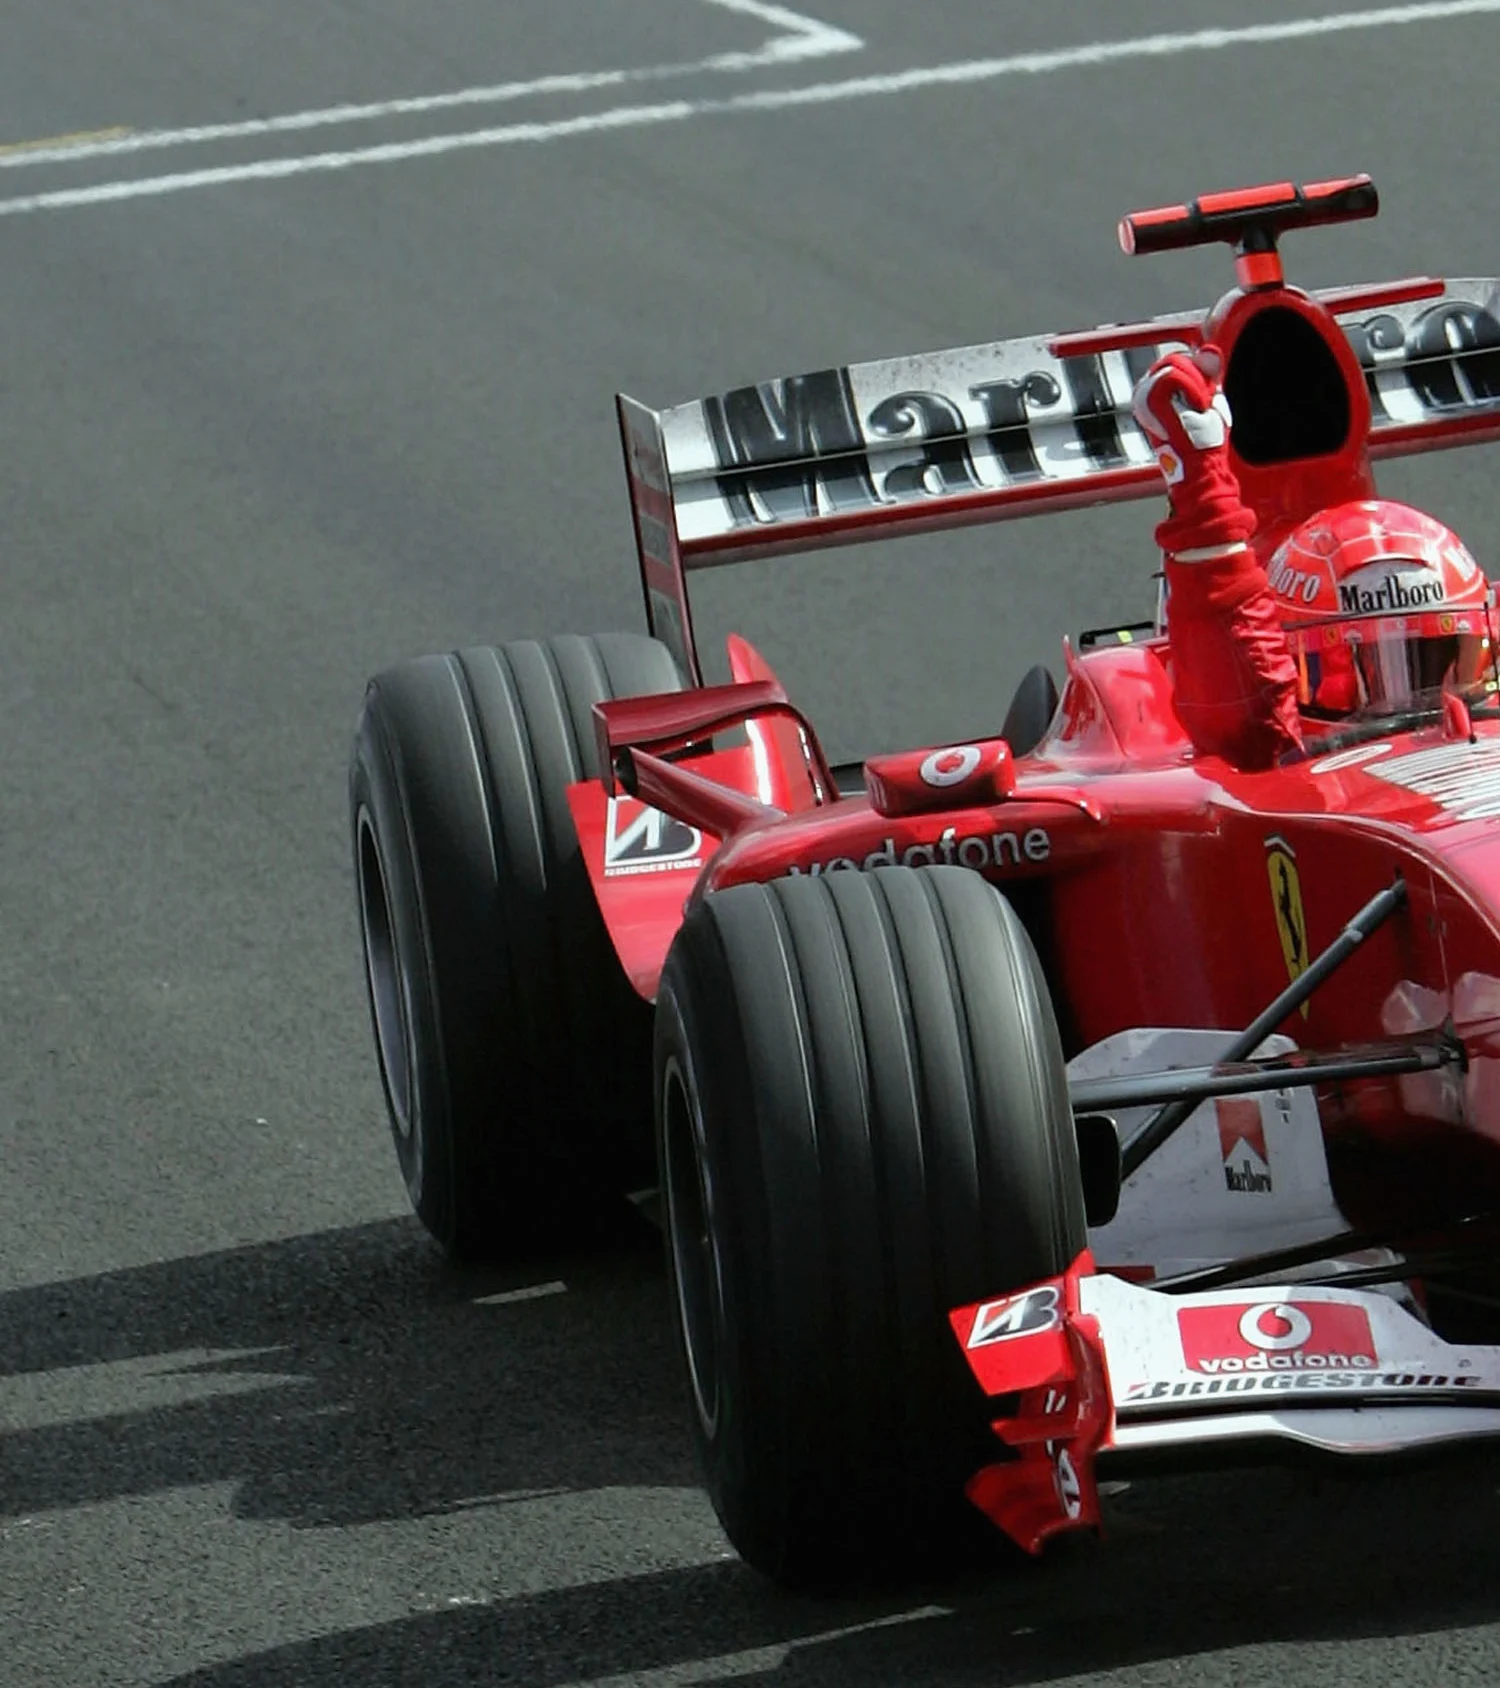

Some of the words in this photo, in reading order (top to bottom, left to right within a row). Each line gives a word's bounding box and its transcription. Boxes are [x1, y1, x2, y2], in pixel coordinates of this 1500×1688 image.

[1339, 574, 1444, 614] Marlboro
[1198, 1350, 1374, 1374] vodafone
[1122, 1372, 1483, 1402] BRIDGESTONE
